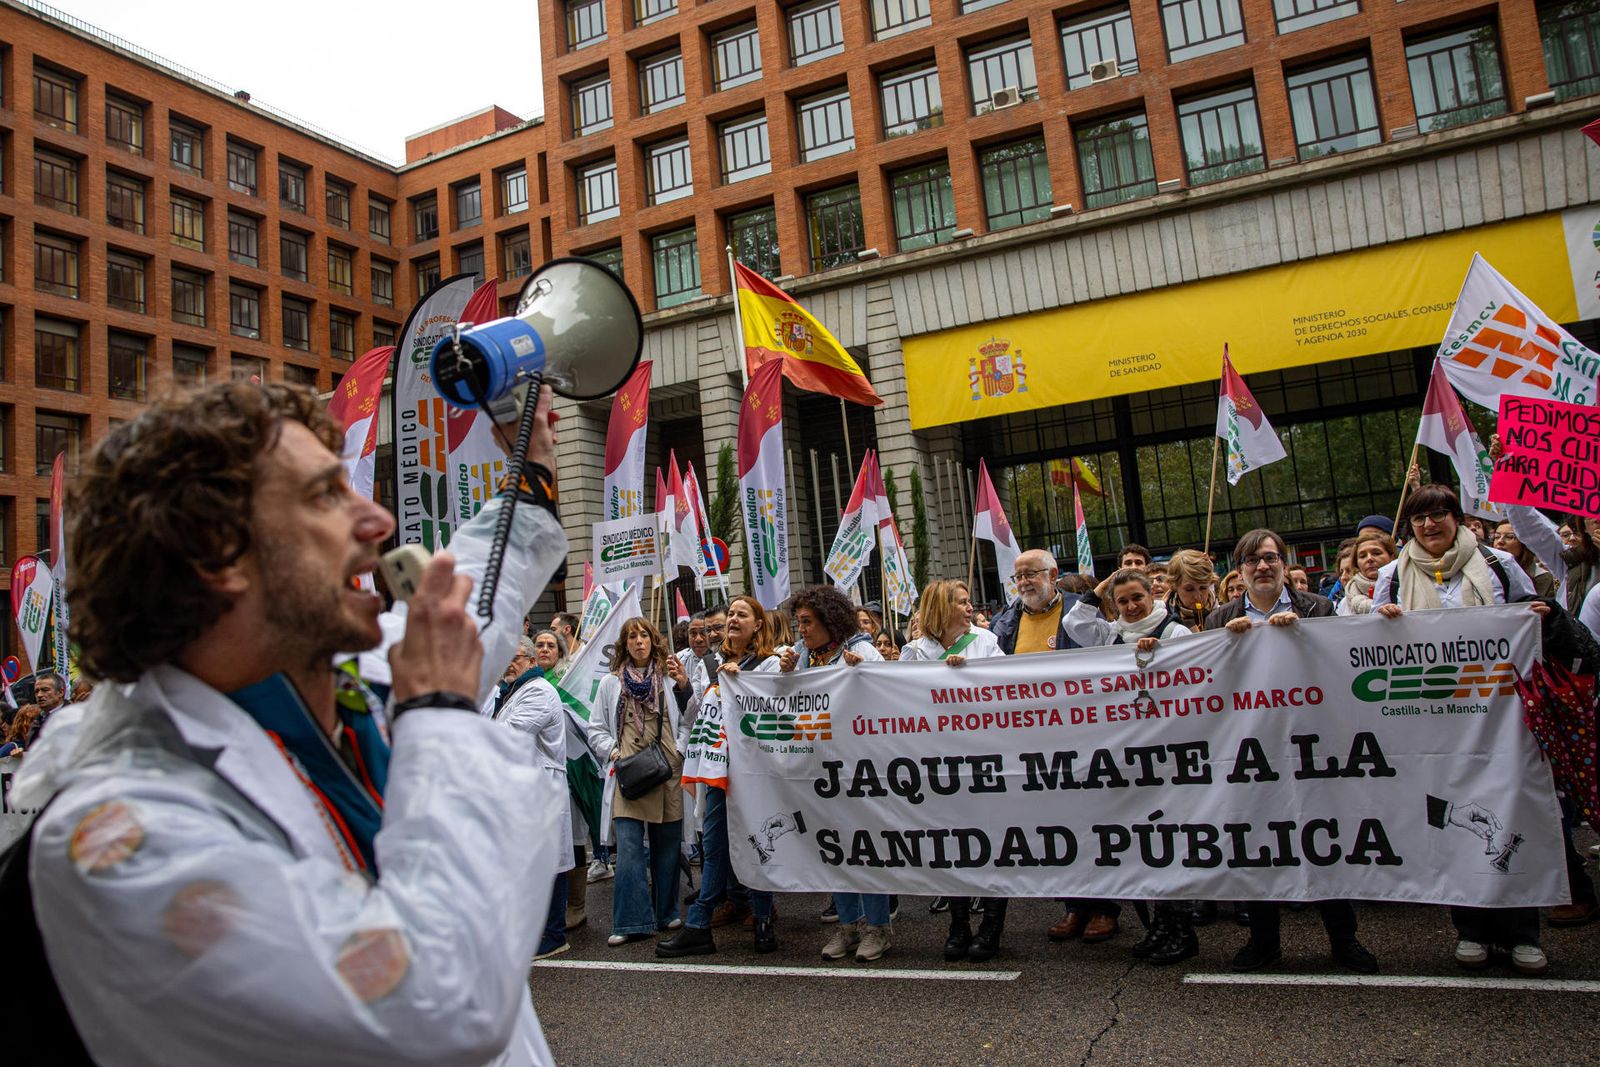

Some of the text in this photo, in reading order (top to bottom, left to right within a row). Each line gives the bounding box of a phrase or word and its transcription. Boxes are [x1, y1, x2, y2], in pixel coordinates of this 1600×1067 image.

[1293, 309, 1346, 325] MINISTERIO
[1294, 300, 1458, 336] DE DERECHOS SOCIALES, CONSUM
[1443, 300, 1498, 357] cesmcv
[1296, 327, 1367, 346] Y AGENDA 2030
[1108, 353, 1156, 367] MINISTERIO
[1110, 362, 1162, 378] DE SANIDAD
[400, 409, 419, 485] MÉDICO
[1506, 426, 1600, 464] NOS CUI
[458, 463, 471, 520] Médico
[1546, 460, 1600, 491] CUID
[746, 487, 758, 530] Médico
[1517, 478, 1600, 515] MEJO
[603, 526, 654, 546] SINDICATO MÉDICO
[776, 488, 787, 564] Región de Murcia
[630, 559, 653, 569] Mancha
[57, 623, 65, 675] Sindicato
[1349, 636, 1510, 667] SINDICATO MÉDICO
[930, 666, 1214, 704] MINISTERIO DE SANIDAD:
[1351, 663, 1516, 703] CESM
[788, 691, 830, 713] MÉDICO
[852, 686, 1324, 735] ÚLTIMA PROPUESTA DE ESTATUTO MARCO
[1381, 705, 1421, 716] Castilla
[1430, 704, 1444, 715] La
[1446, 703, 1488, 715] Mancha
[780, 745, 788, 754] La
[789, 745, 814, 754] Mancha
[813, 731, 1397, 805] JAQUE MATE A LA
[816, 809, 1403, 868] SANIDAD PÚBLICA
